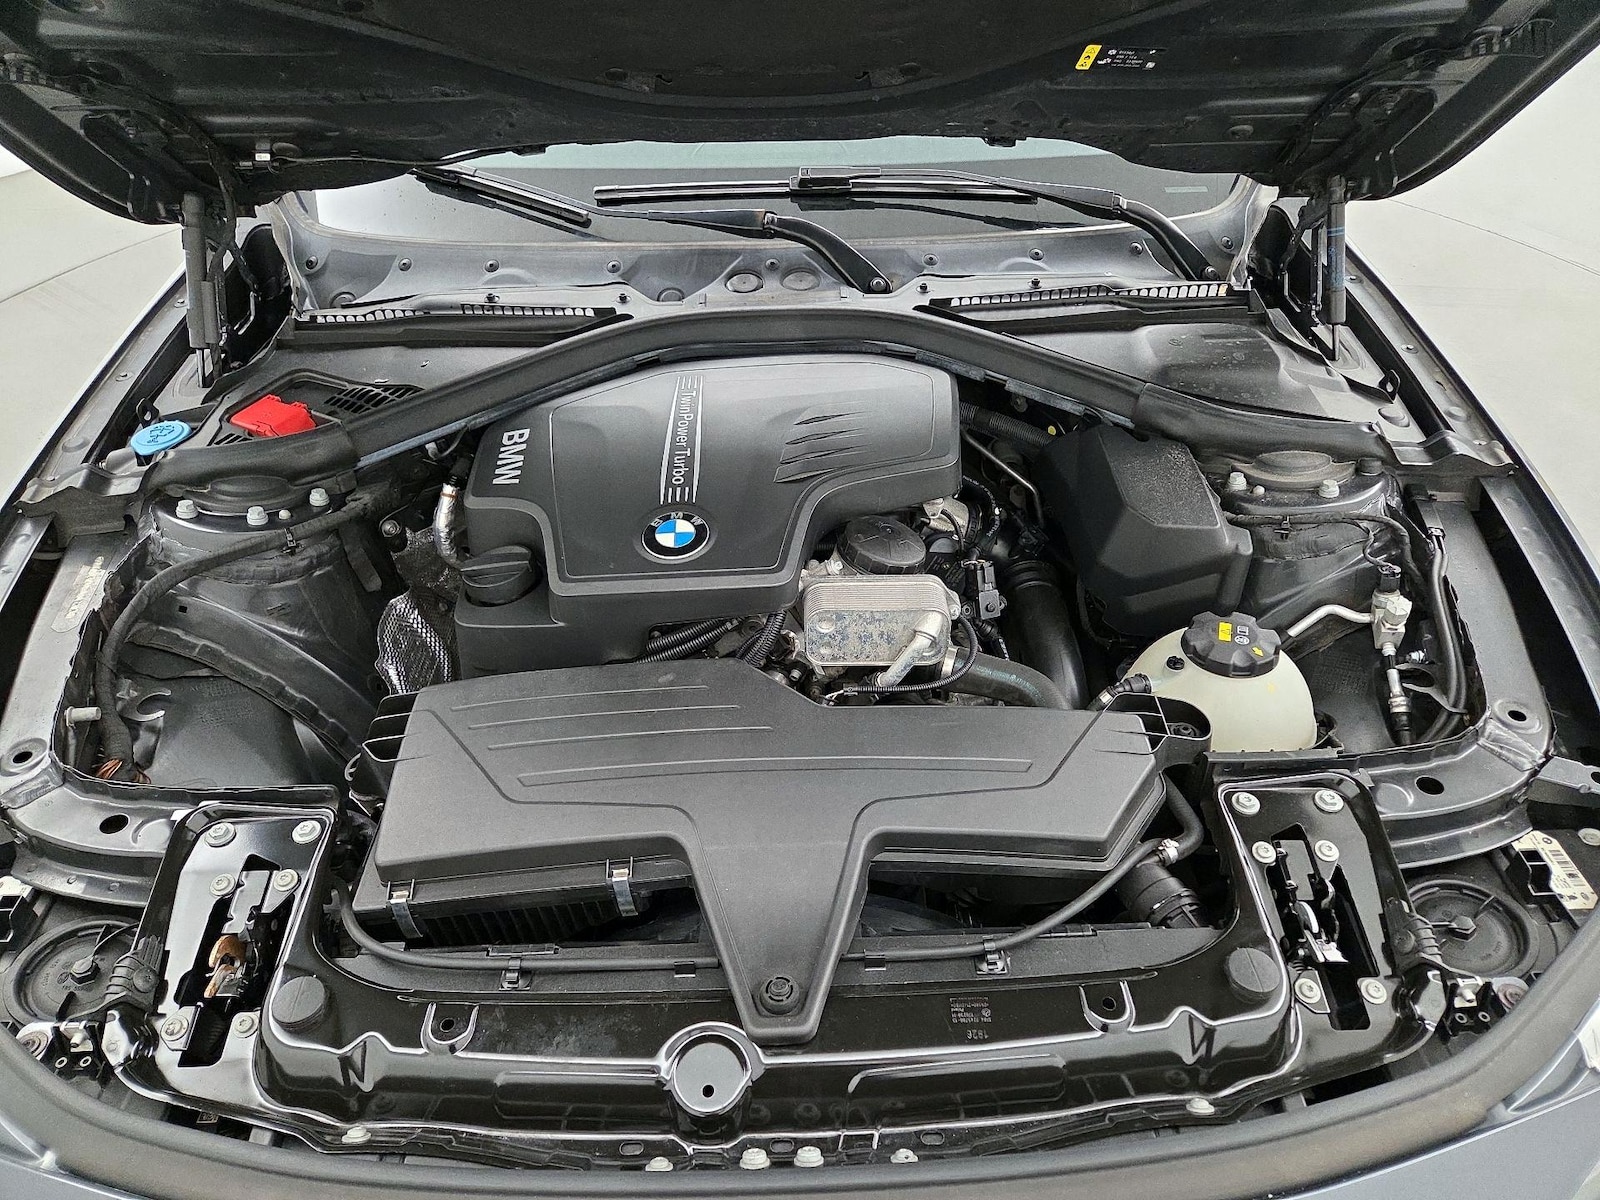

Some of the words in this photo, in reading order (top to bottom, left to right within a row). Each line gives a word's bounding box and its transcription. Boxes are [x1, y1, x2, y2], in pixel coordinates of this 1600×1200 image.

[675, 390, 697, 447] TwinPower
[492, 428, 531, 485] BMW
[671, 447, 691, 485] Turbo
[651, 511, 704, 528] BMW
